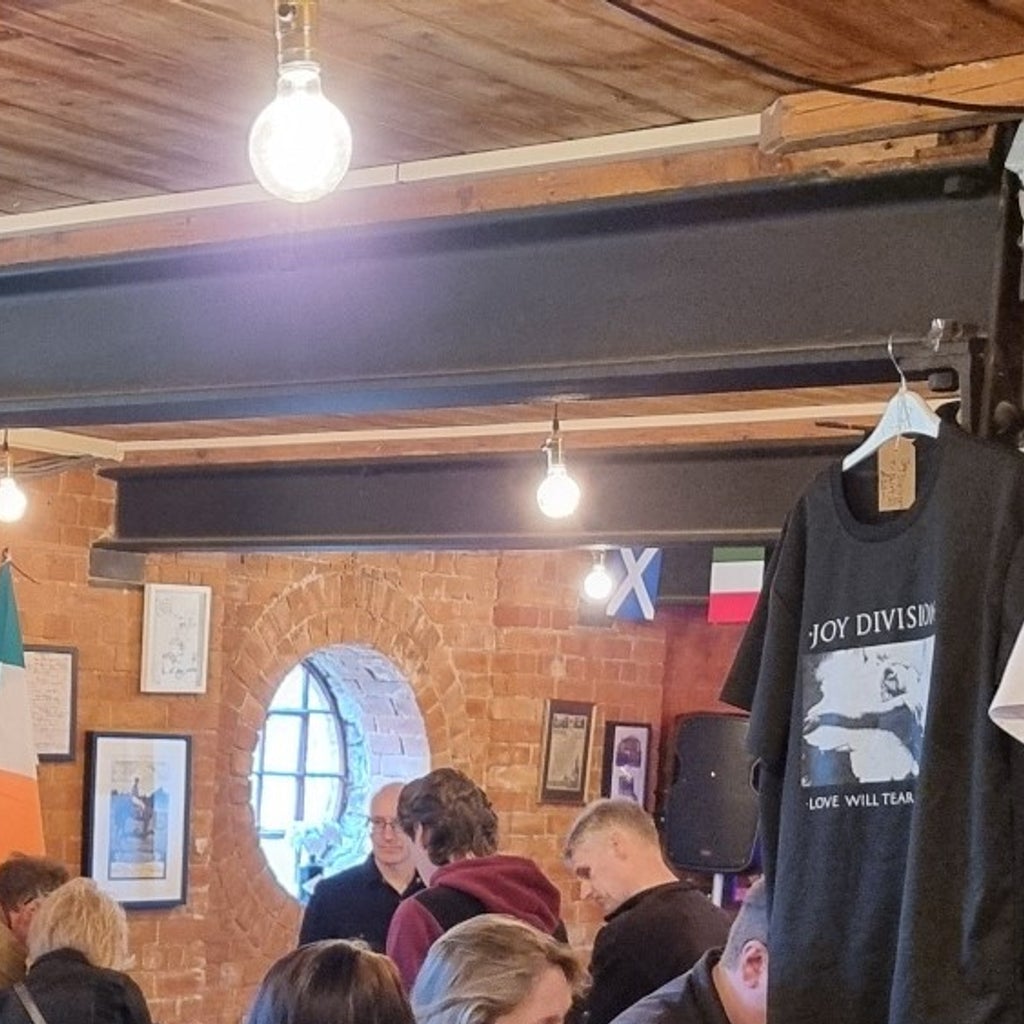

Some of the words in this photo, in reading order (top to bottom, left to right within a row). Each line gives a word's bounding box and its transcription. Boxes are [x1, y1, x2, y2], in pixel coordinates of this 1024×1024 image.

[809, 616, 850, 649] JOY
[809, 795, 840, 811] LOVE
[844, 793, 880, 807] WILL
[881, 791, 915, 805] TEAR
